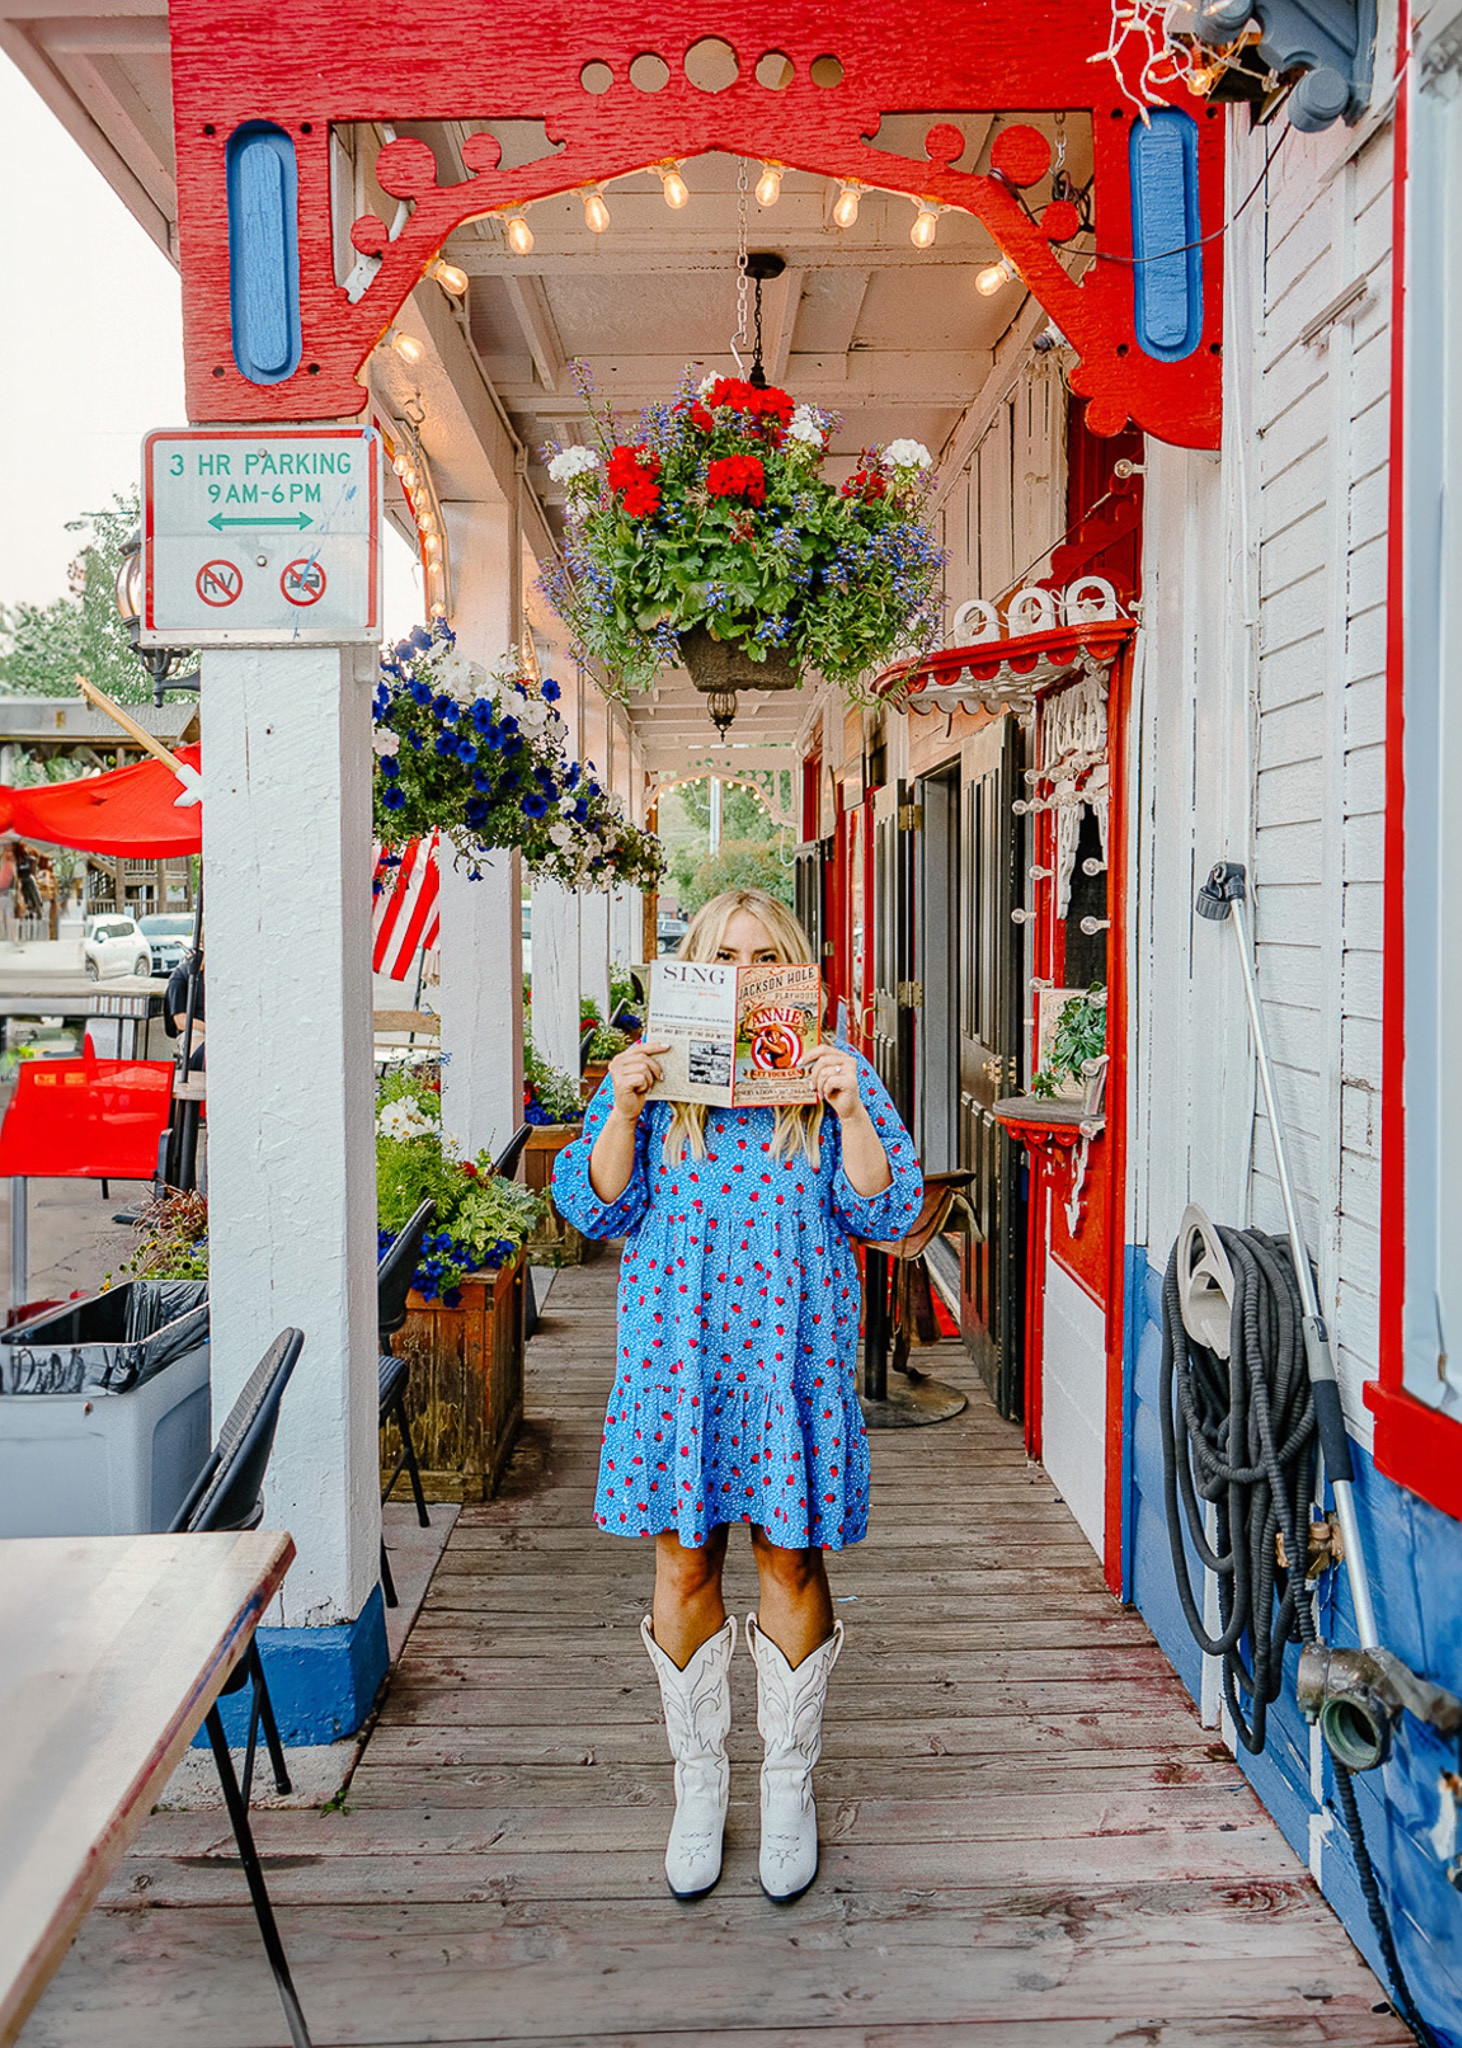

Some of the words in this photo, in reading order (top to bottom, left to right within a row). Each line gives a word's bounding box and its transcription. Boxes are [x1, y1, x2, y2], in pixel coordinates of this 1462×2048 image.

[169, 454, 185, 476] 3
[199, 454, 231, 476] HR
[245, 453, 351, 475] PARKING
[203, 572, 234, 594] RV
[663, 965, 726, 985] SING
[738, 976, 783, 1000] JACKSON
[788, 967, 815, 984] HOLE
[752, 1007, 802, 1027] ANNIE
